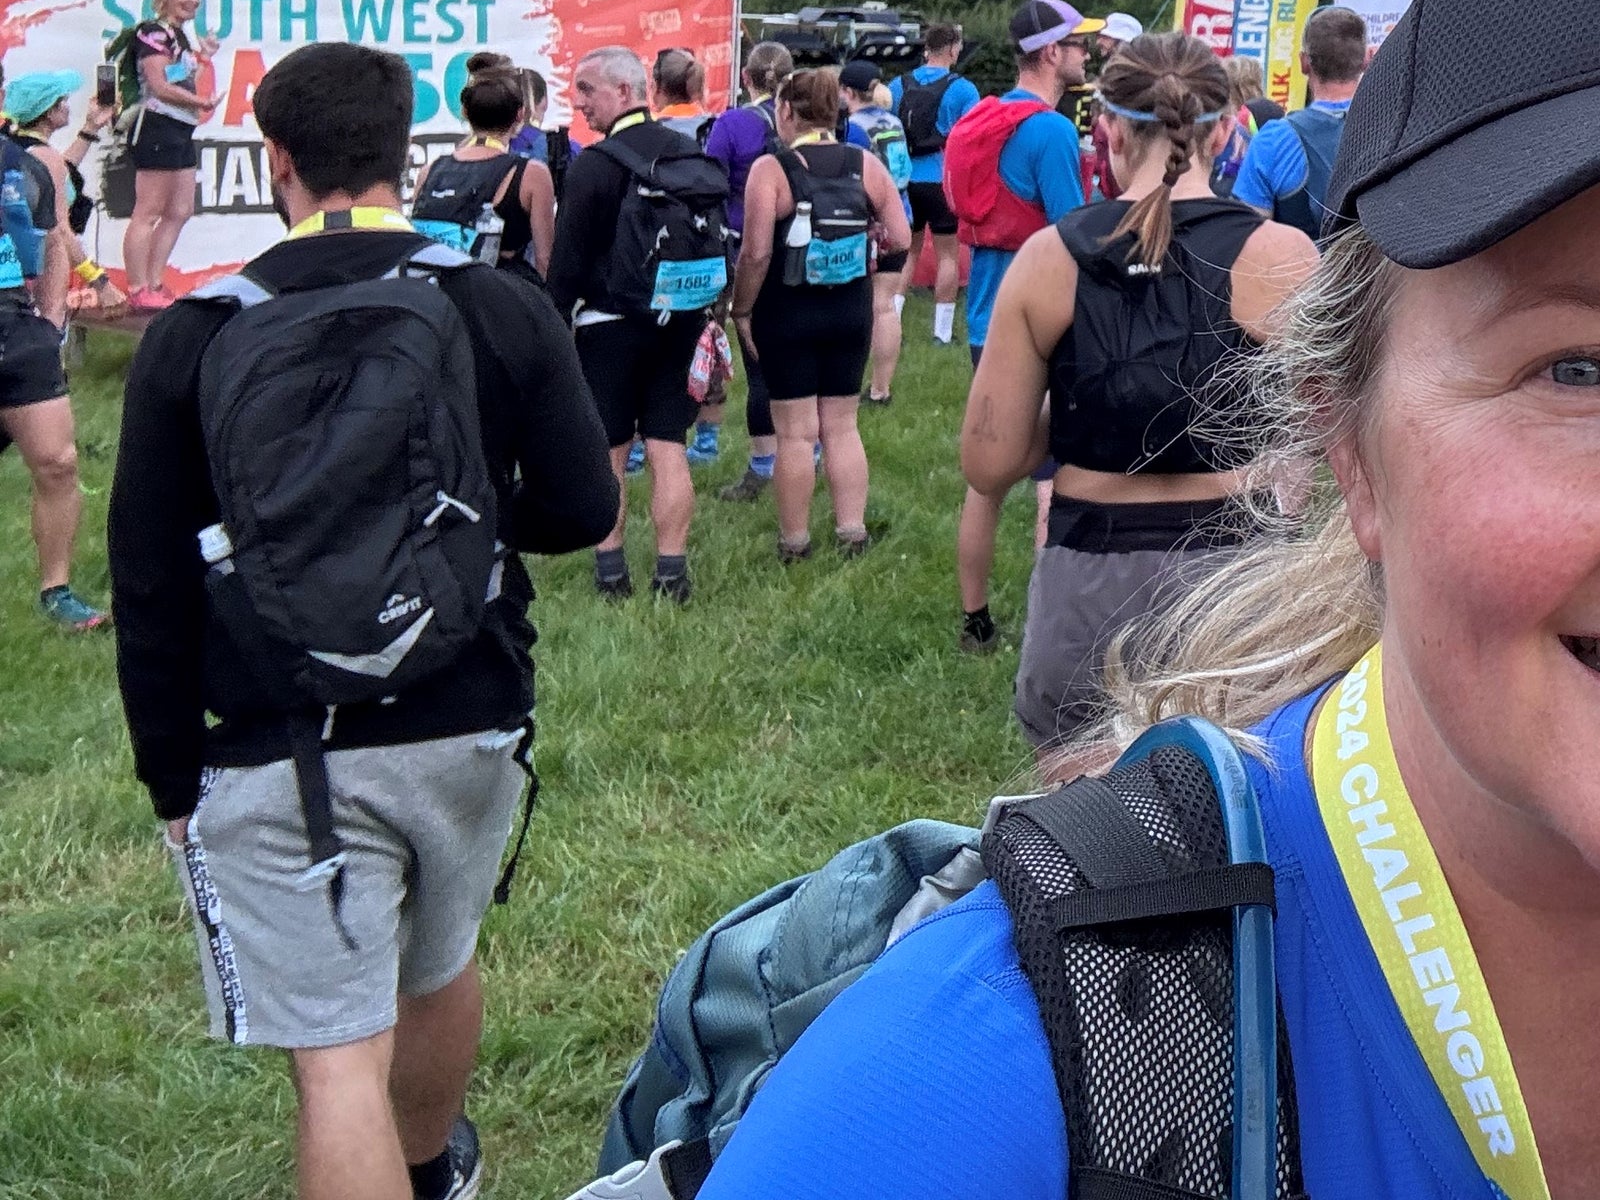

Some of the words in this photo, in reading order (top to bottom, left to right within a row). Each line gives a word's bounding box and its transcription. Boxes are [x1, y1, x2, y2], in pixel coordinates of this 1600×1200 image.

[1271, 67, 1292, 111] ALK
[1335, 659, 1372, 761] 2024
[1340, 763, 1517, 1159] CHALLENGER
